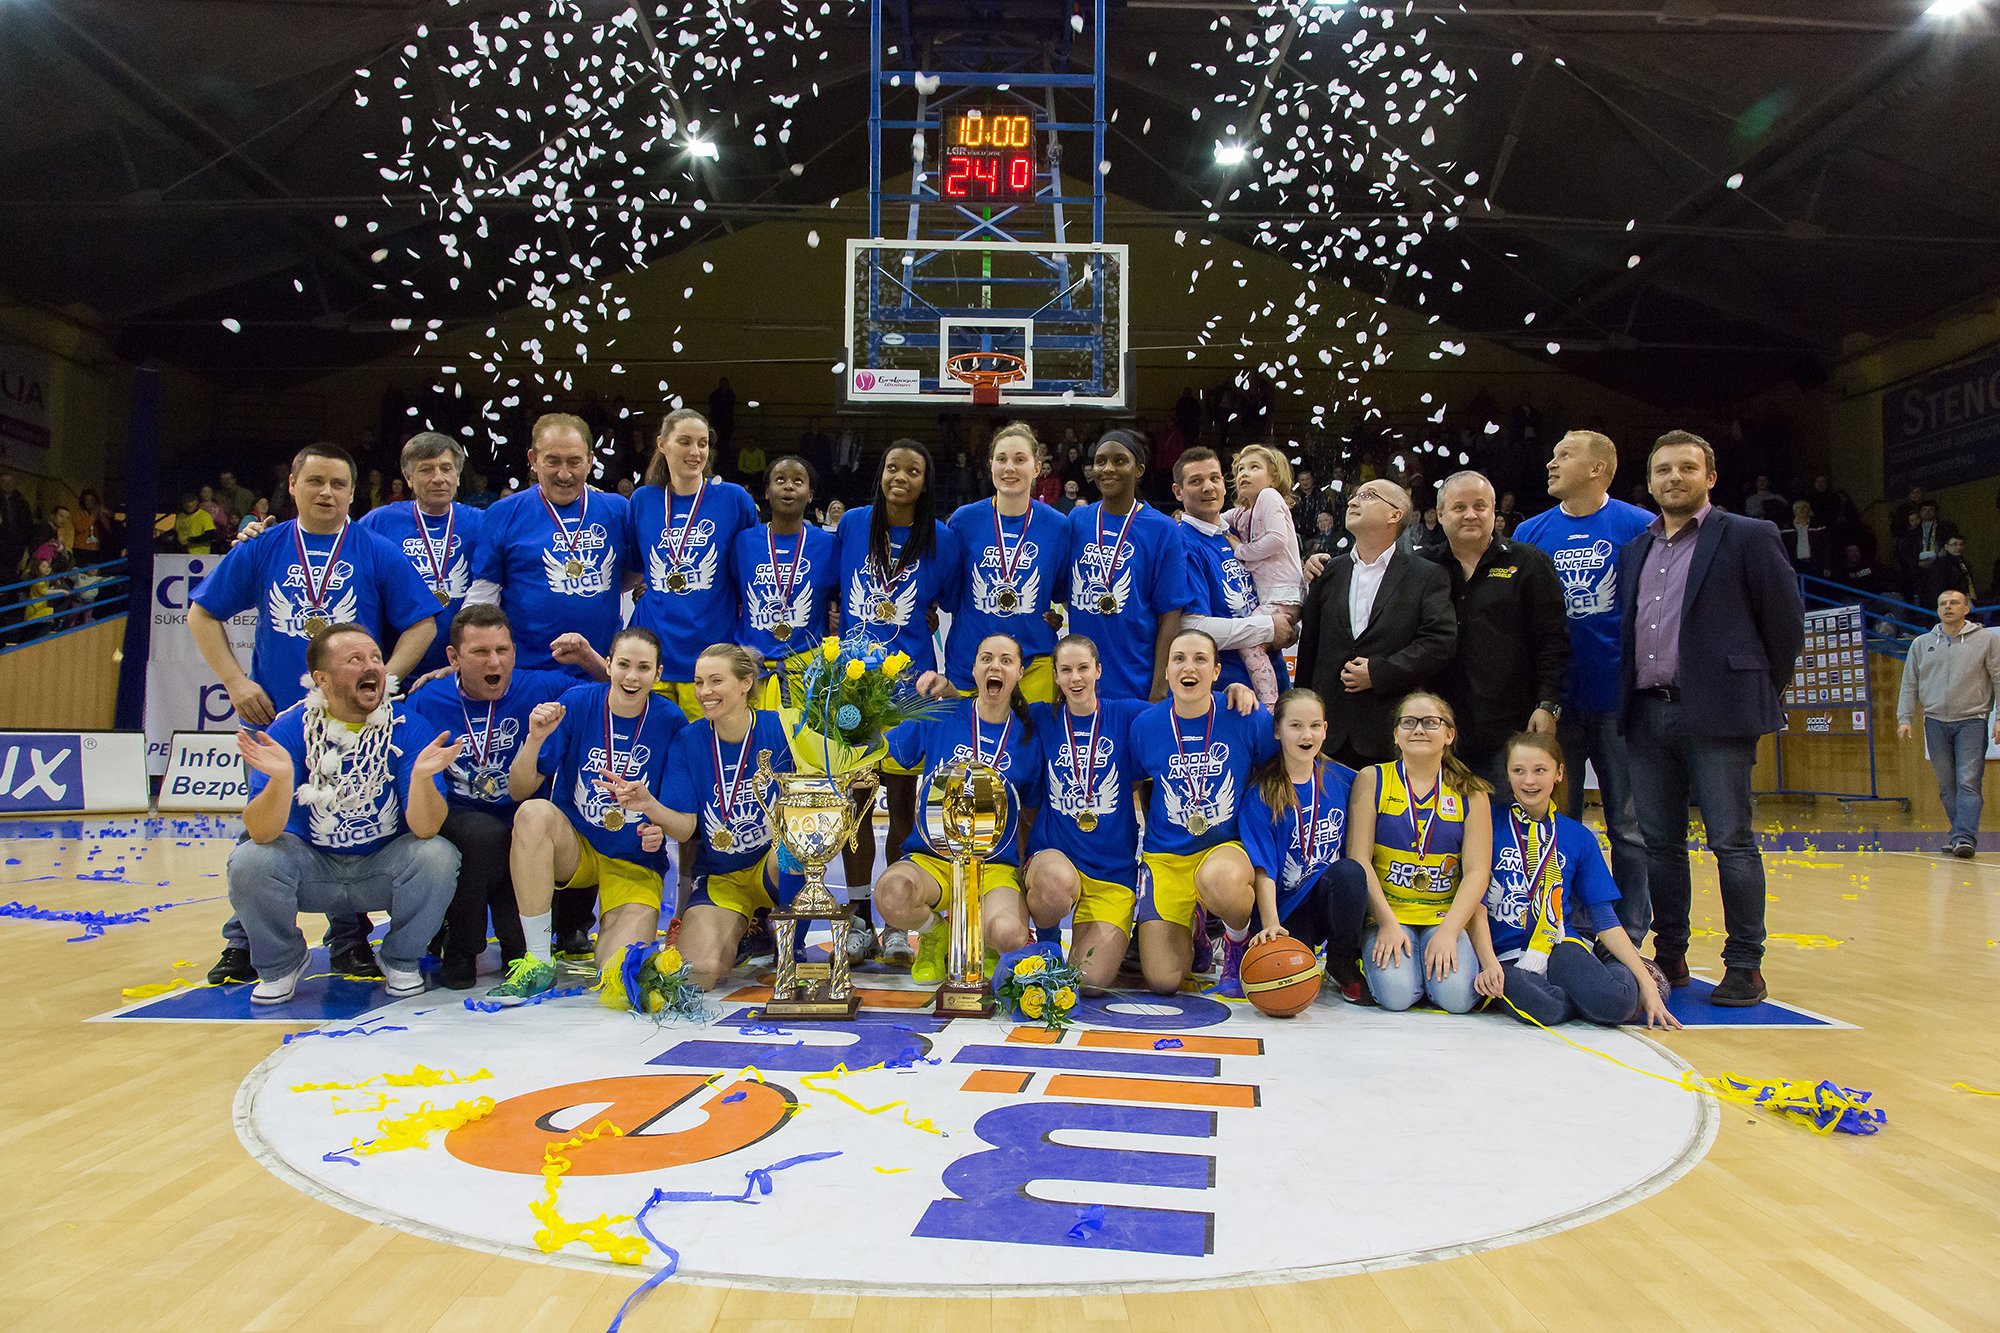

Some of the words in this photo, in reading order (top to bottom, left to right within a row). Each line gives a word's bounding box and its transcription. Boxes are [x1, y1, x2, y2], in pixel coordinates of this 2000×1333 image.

[947, 157, 997, 196] 24
[1010, 158, 1029, 190] 0
[981, 556, 1030, 568] ANLS
[1554, 548, 1594, 561] GOOD
[1553, 558, 1605, 569] ANGELS
[285, 575, 343, 589] ANLS
[561, 573, 605, 591] TUCET
[660, 571, 702, 589] TET
[981, 594, 1024, 609] TUT
[284, 615, 337, 632] TUT
[1170, 754, 1210, 766] GOOD
[1169, 763, 1221, 777] ANGELS
[326, 822, 383, 845] TUCET
[732, 825, 768, 848] UCET
[1386, 872, 1453, 893] ANELS
